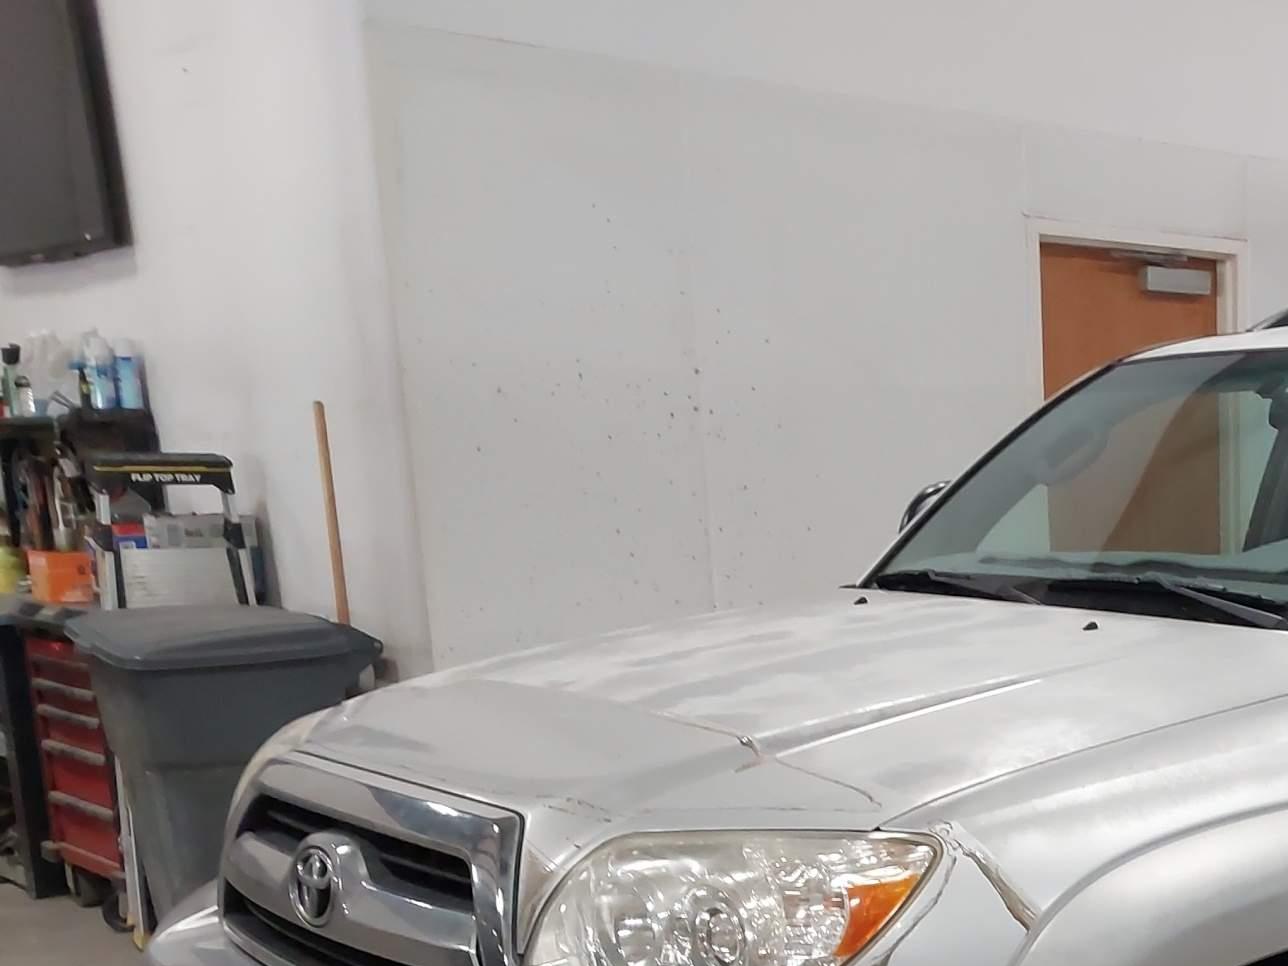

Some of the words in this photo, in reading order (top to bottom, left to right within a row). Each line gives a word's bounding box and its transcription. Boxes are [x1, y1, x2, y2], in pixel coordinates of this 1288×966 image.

[130, 473, 153, 482] FLIP
[153, 473, 174, 482] TOP
[175, 473, 201, 482] TRAY
